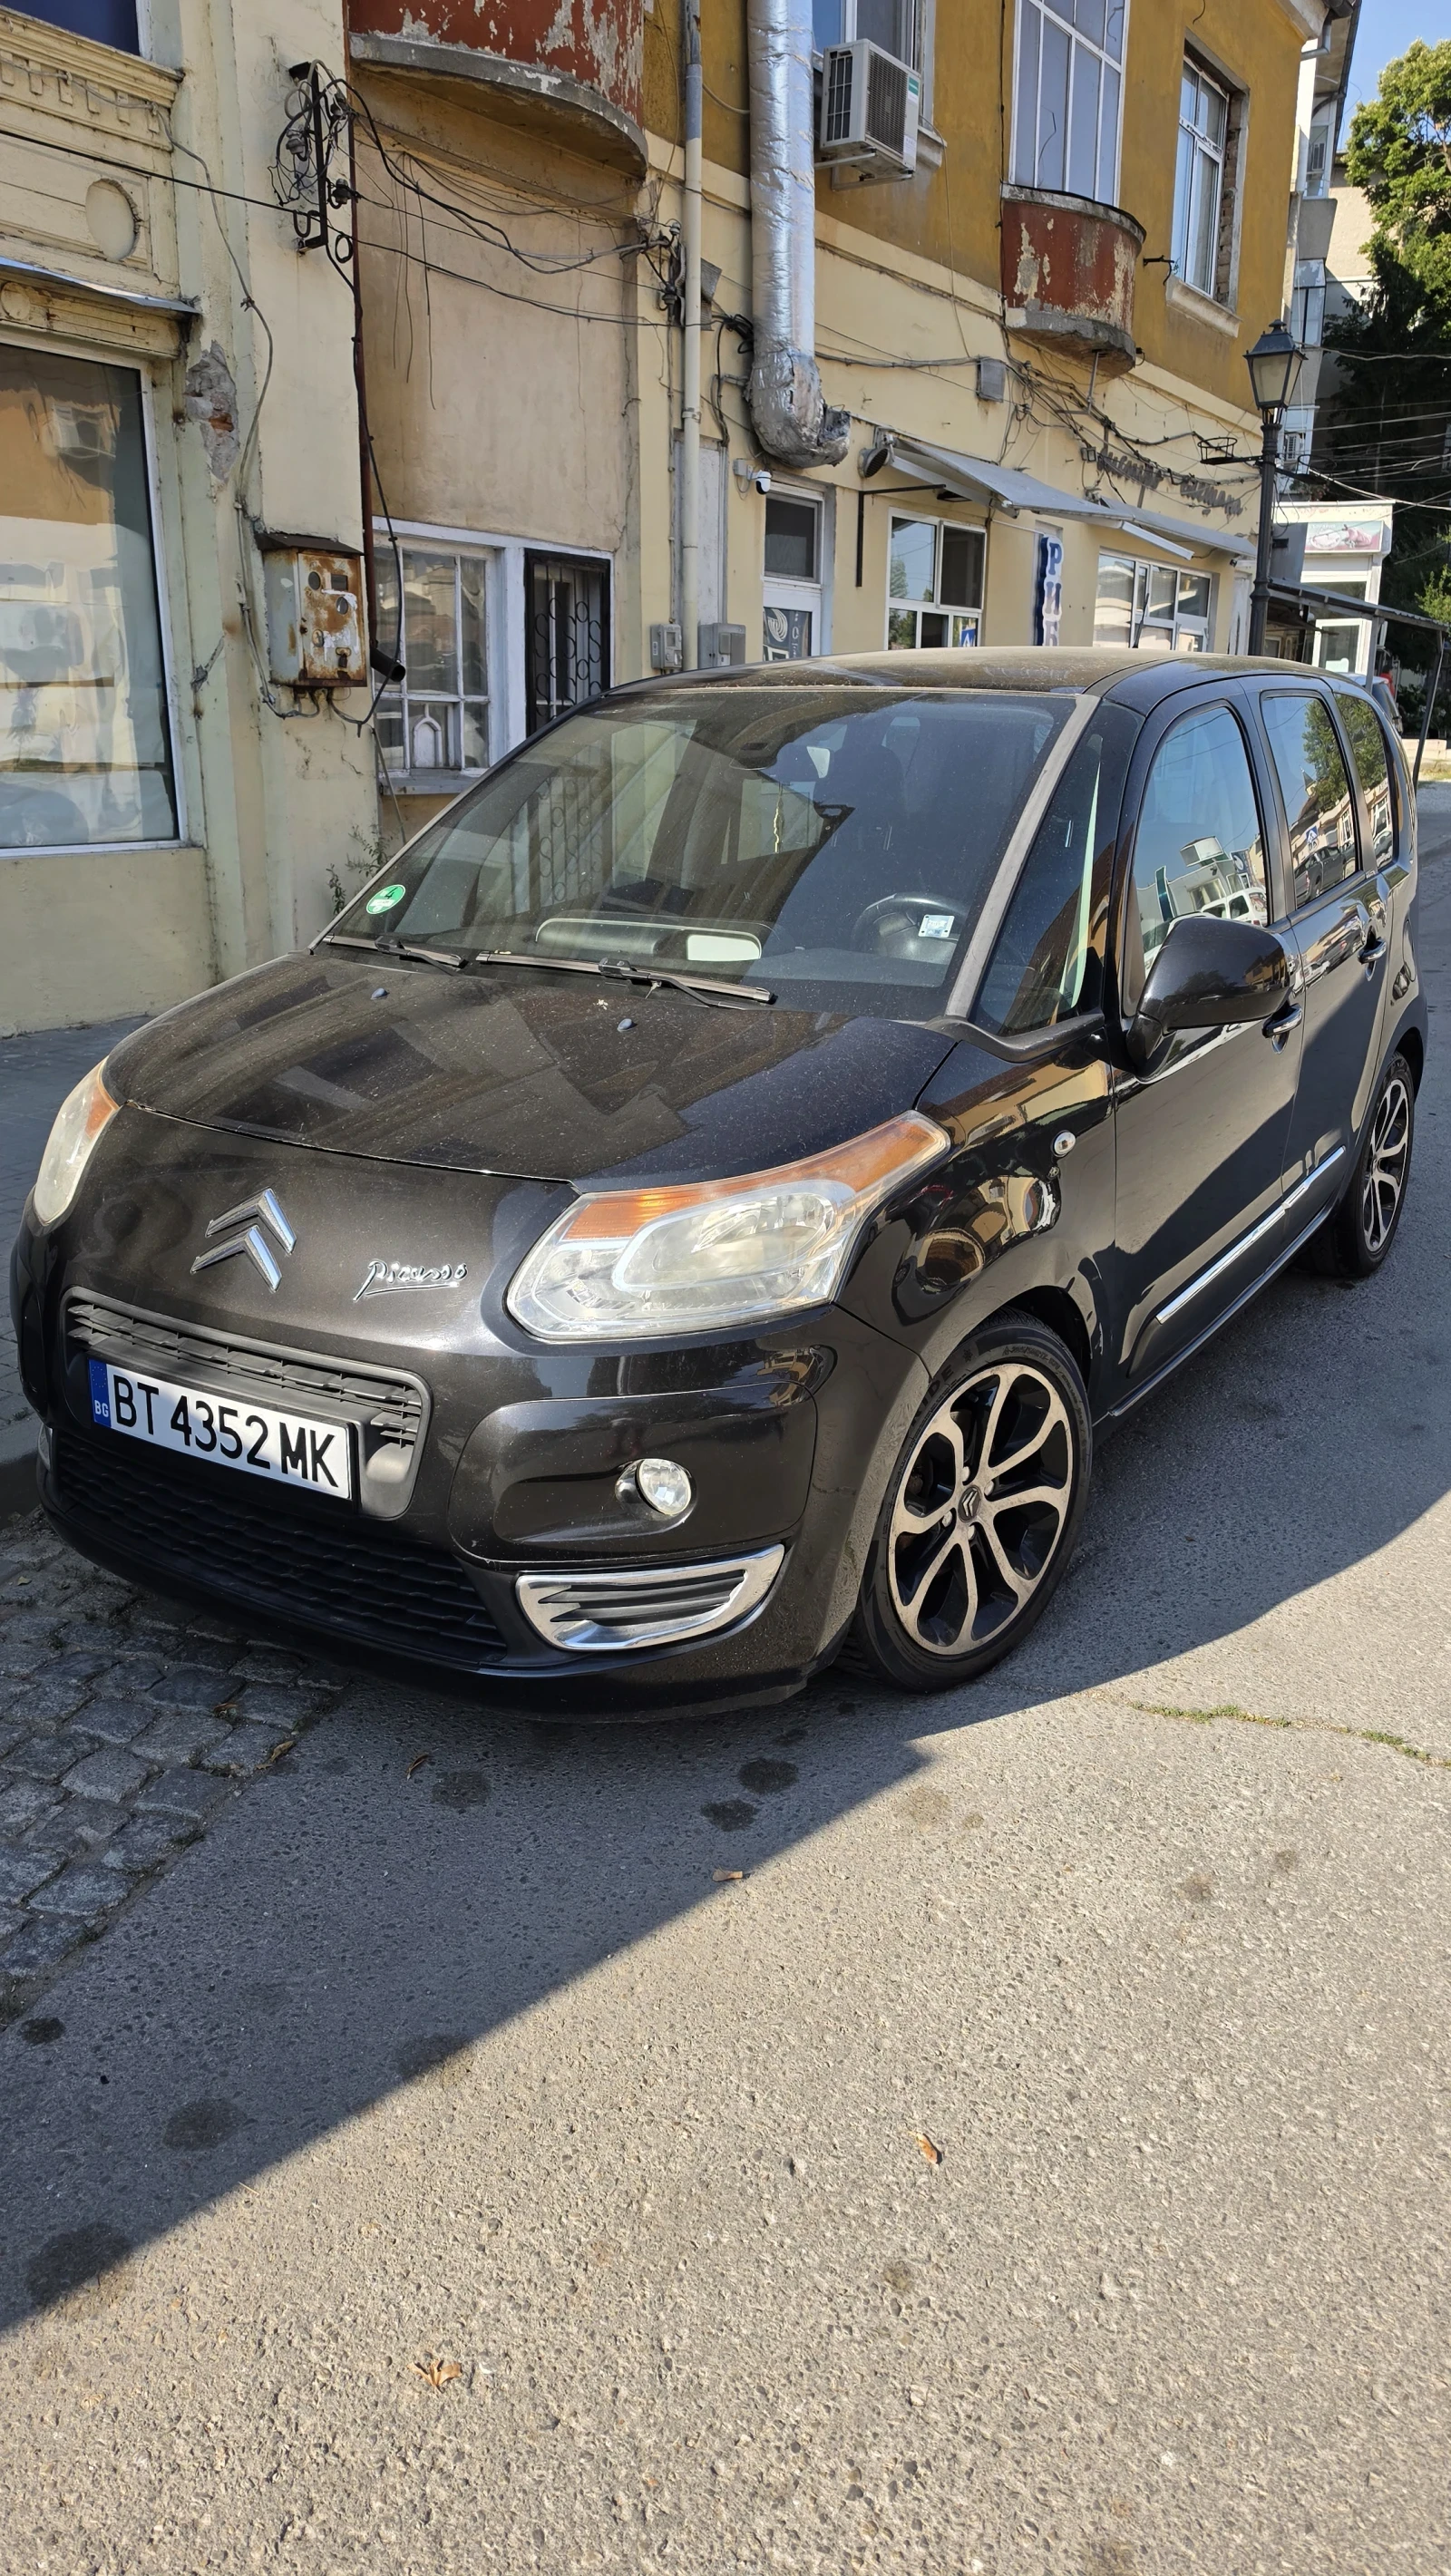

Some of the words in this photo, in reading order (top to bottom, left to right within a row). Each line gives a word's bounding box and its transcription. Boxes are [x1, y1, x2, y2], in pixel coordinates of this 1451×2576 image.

[385, 887, 398, 899] 4
[353, 1259, 467, 1301] Picasso
[94, 1399, 109, 1417] BG
[113, 1374, 159, 1435] BT
[170, 1395, 271, 1470] 4352
[279, 1421, 339, 1488] MK
